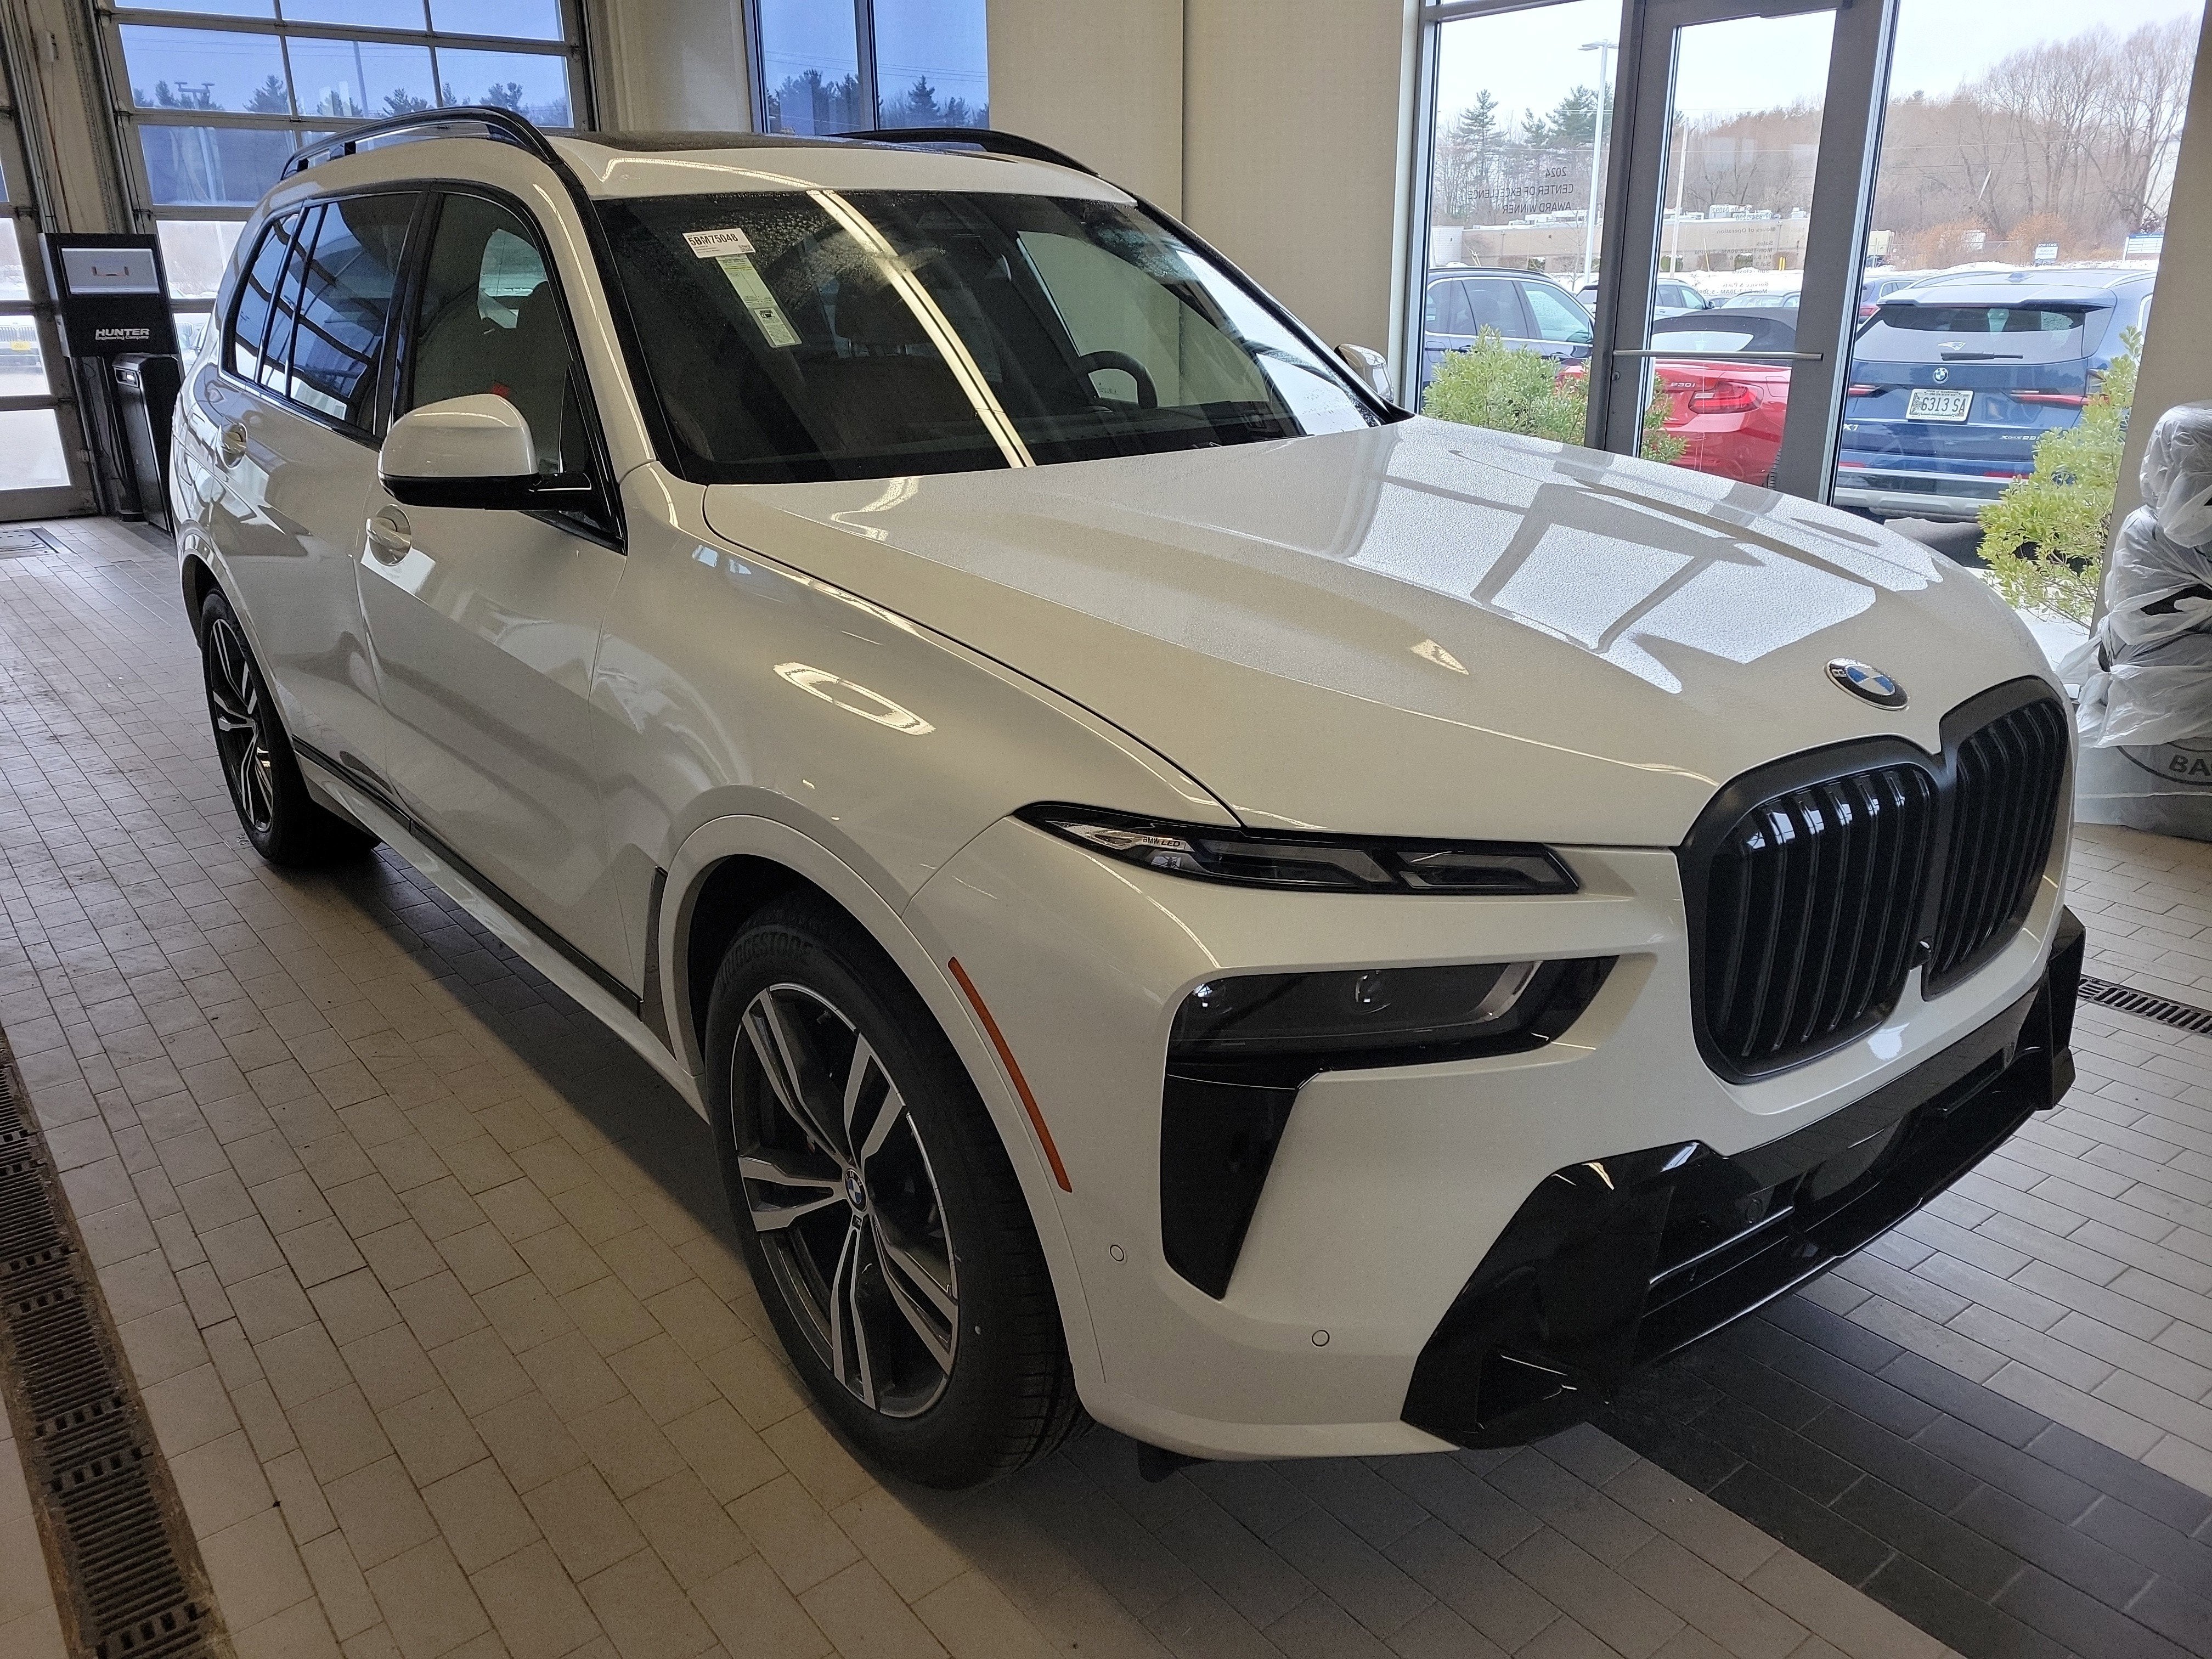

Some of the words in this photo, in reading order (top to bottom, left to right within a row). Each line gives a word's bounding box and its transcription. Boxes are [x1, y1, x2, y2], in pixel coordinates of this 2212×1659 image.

[688, 233, 738, 246] 5BM75048
[95, 328, 149, 336] HUNTER
[1921, 397, 1950, 411] 6313
[1952, 398, 1966, 413] SA
[2169, 754, 2212, 777] BA
